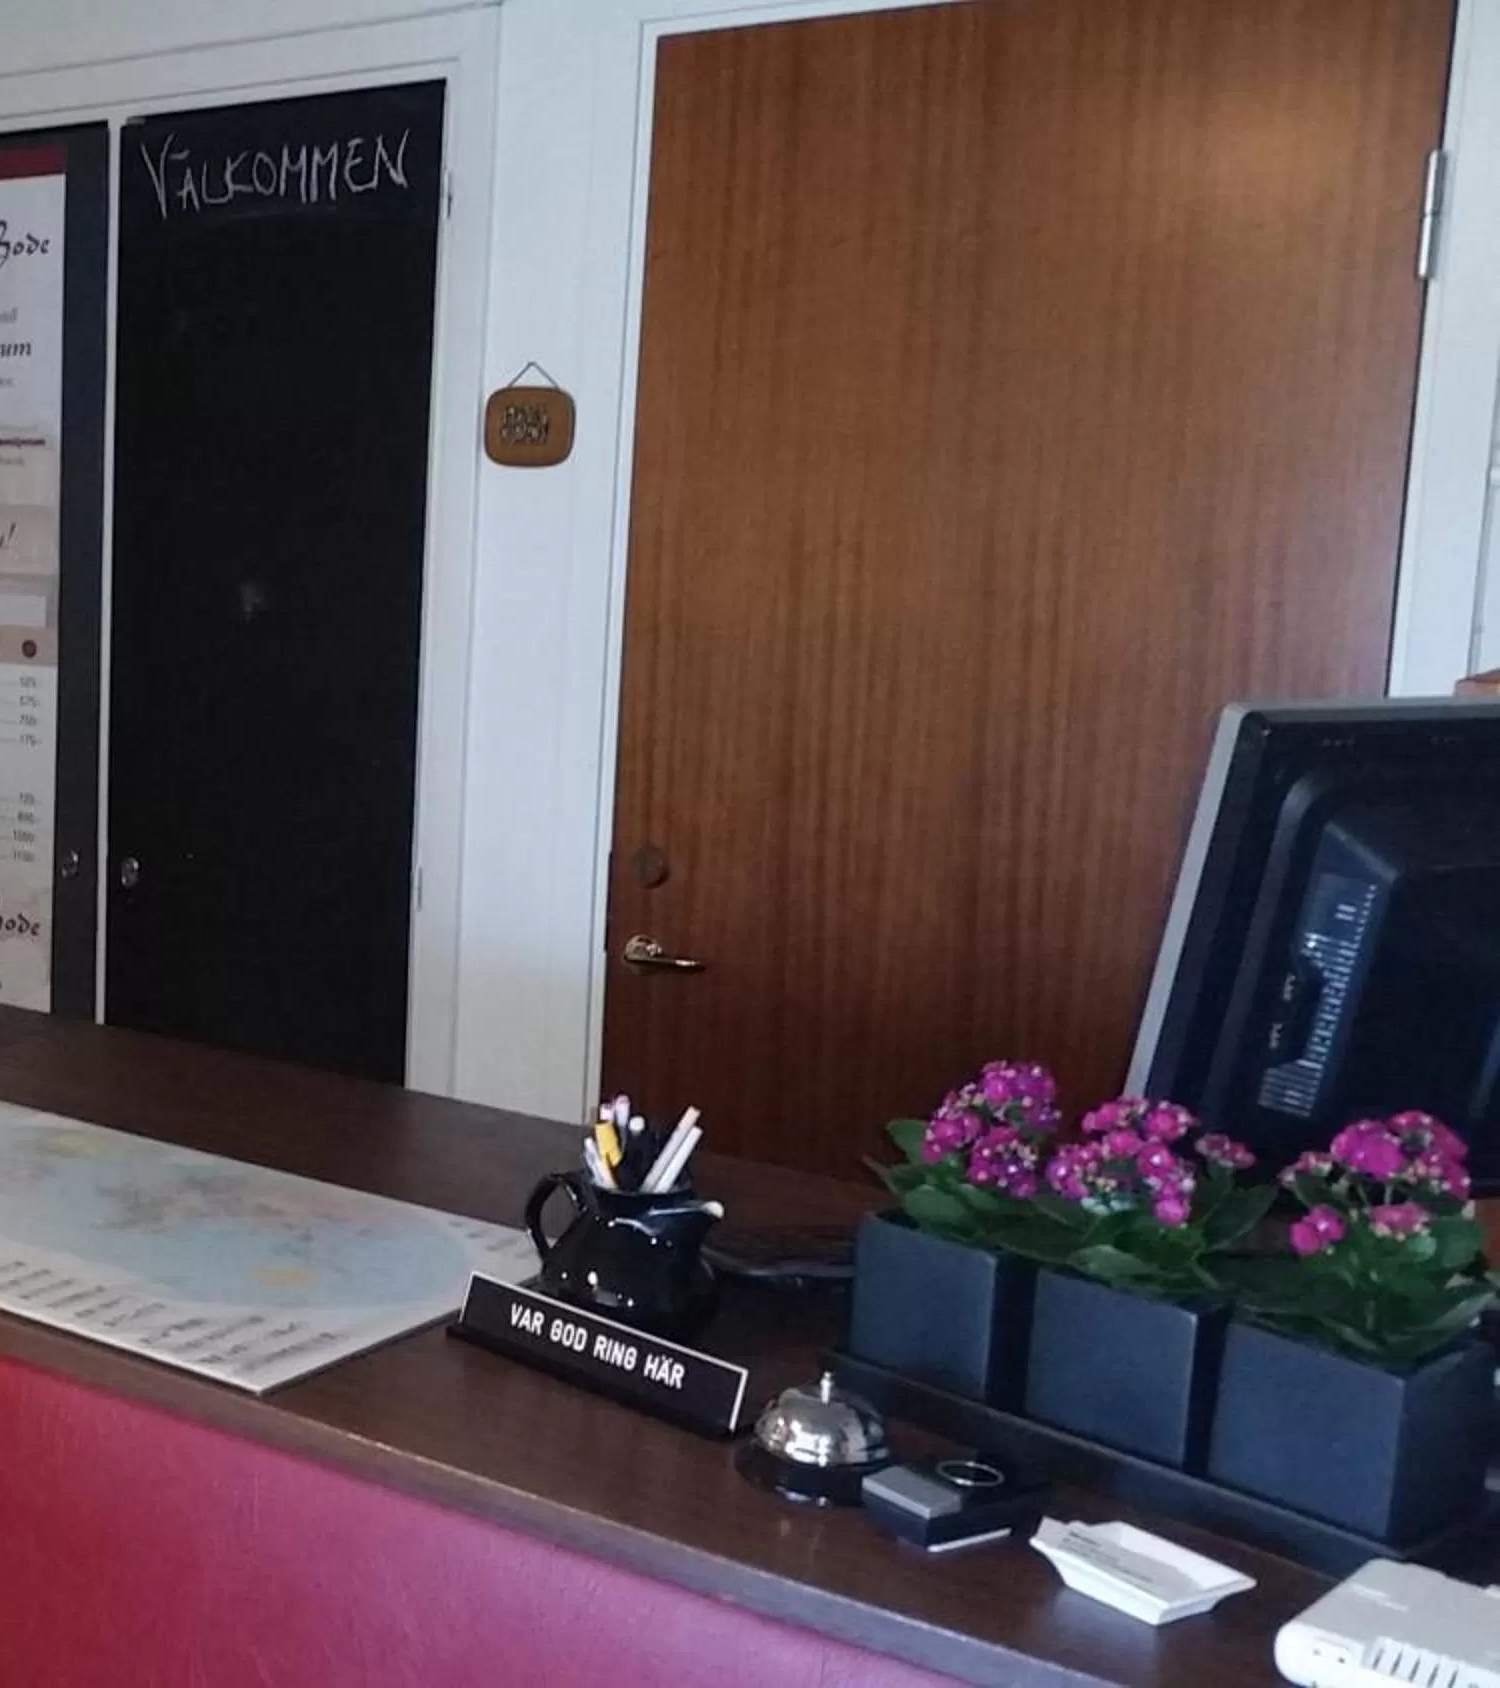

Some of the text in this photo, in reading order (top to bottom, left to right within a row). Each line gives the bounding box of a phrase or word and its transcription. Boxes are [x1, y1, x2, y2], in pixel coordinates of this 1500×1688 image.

[510, 1302, 686, 1390] VAR GOD RING HÄR
